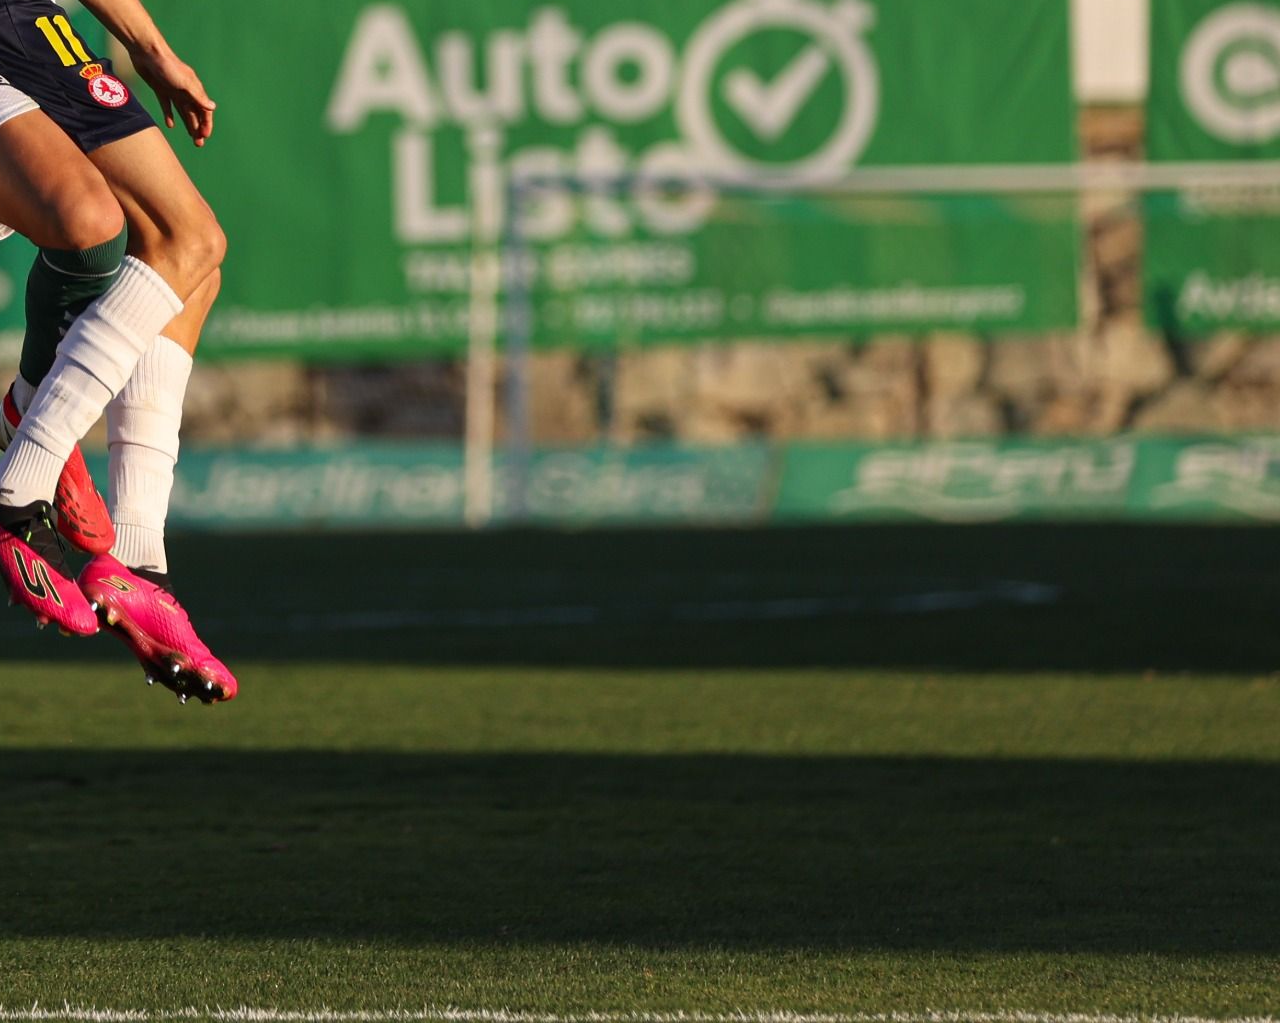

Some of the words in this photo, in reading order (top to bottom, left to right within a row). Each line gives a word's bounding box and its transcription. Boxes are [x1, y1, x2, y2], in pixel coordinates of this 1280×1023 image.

[35, 14, 92, 67] 11
[330, 5, 676, 131] Auto
[396, 128, 713, 242] Listo
